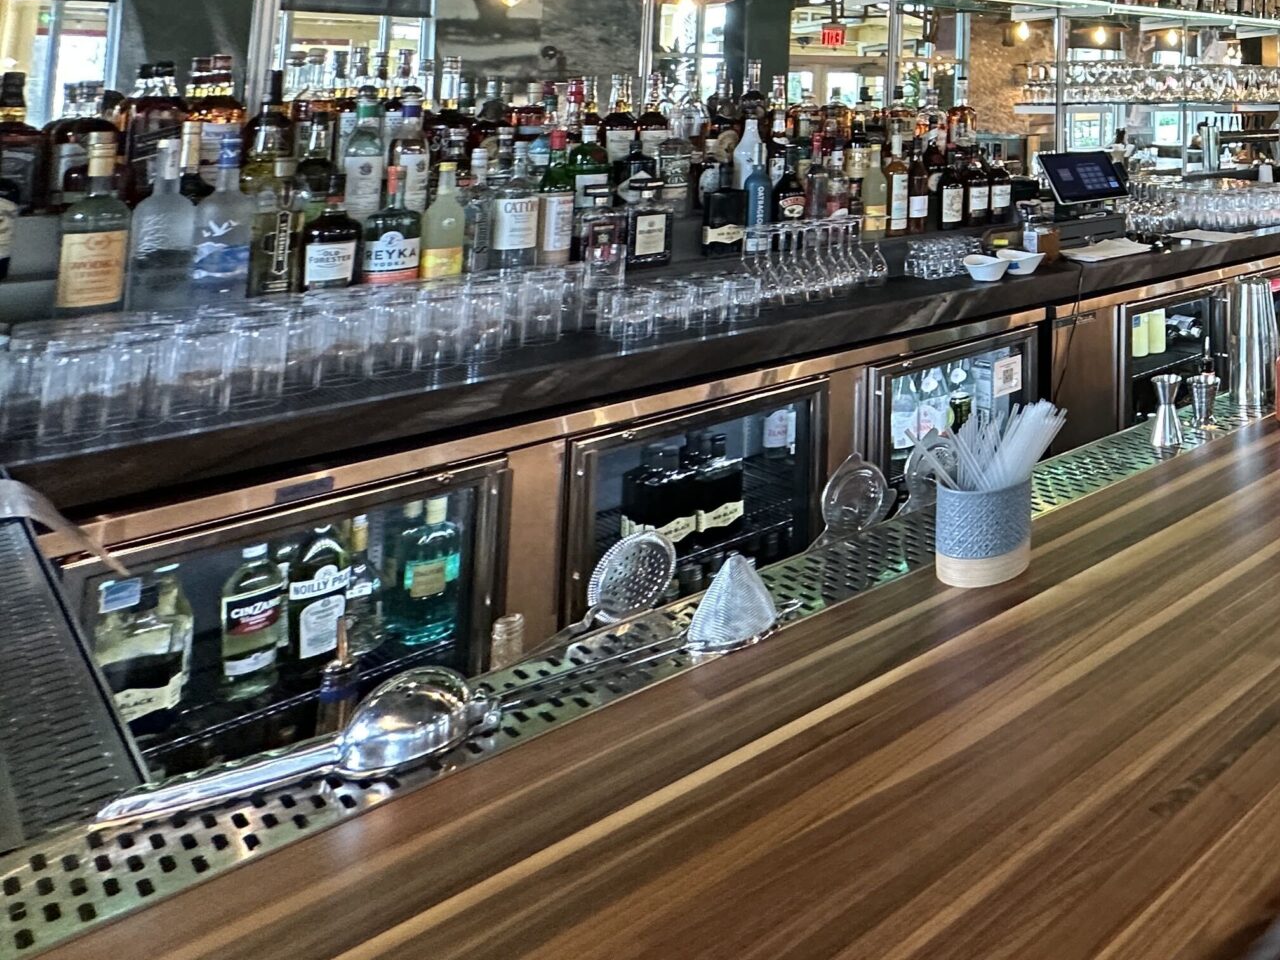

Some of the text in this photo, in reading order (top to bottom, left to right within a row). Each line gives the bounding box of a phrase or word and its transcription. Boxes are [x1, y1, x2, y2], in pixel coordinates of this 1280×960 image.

[366, 247, 417, 260] REYKA
[293, 578, 330, 595] NOILLY
[332, 569, 352, 588] PRA
